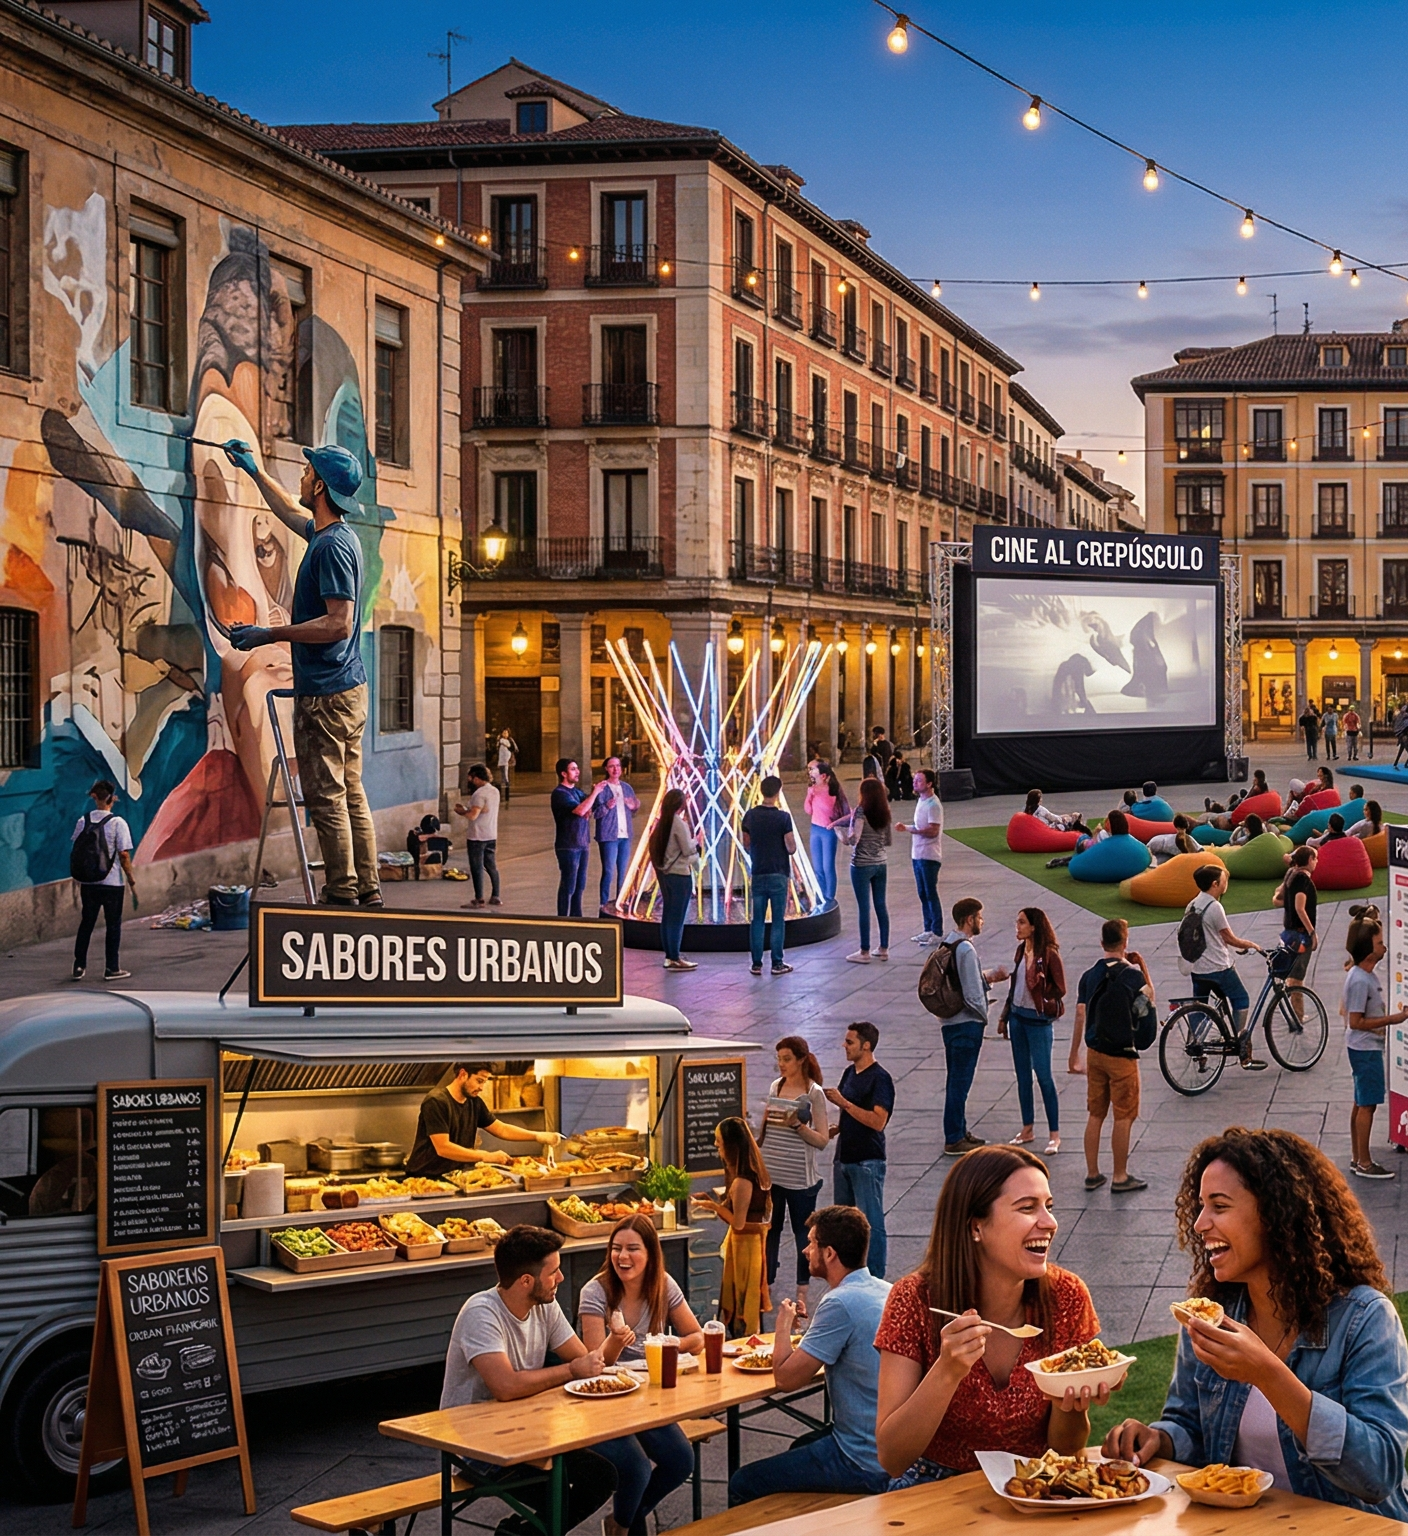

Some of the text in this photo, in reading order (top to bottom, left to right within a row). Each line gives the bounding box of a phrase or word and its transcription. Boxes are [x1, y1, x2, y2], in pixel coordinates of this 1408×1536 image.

[990, 536, 1204, 571] CINE AL CREPÚSCULO
[281, 930, 603, 985] SABORES URBANOS
[129, 1286, 210, 1315] URBANOS
